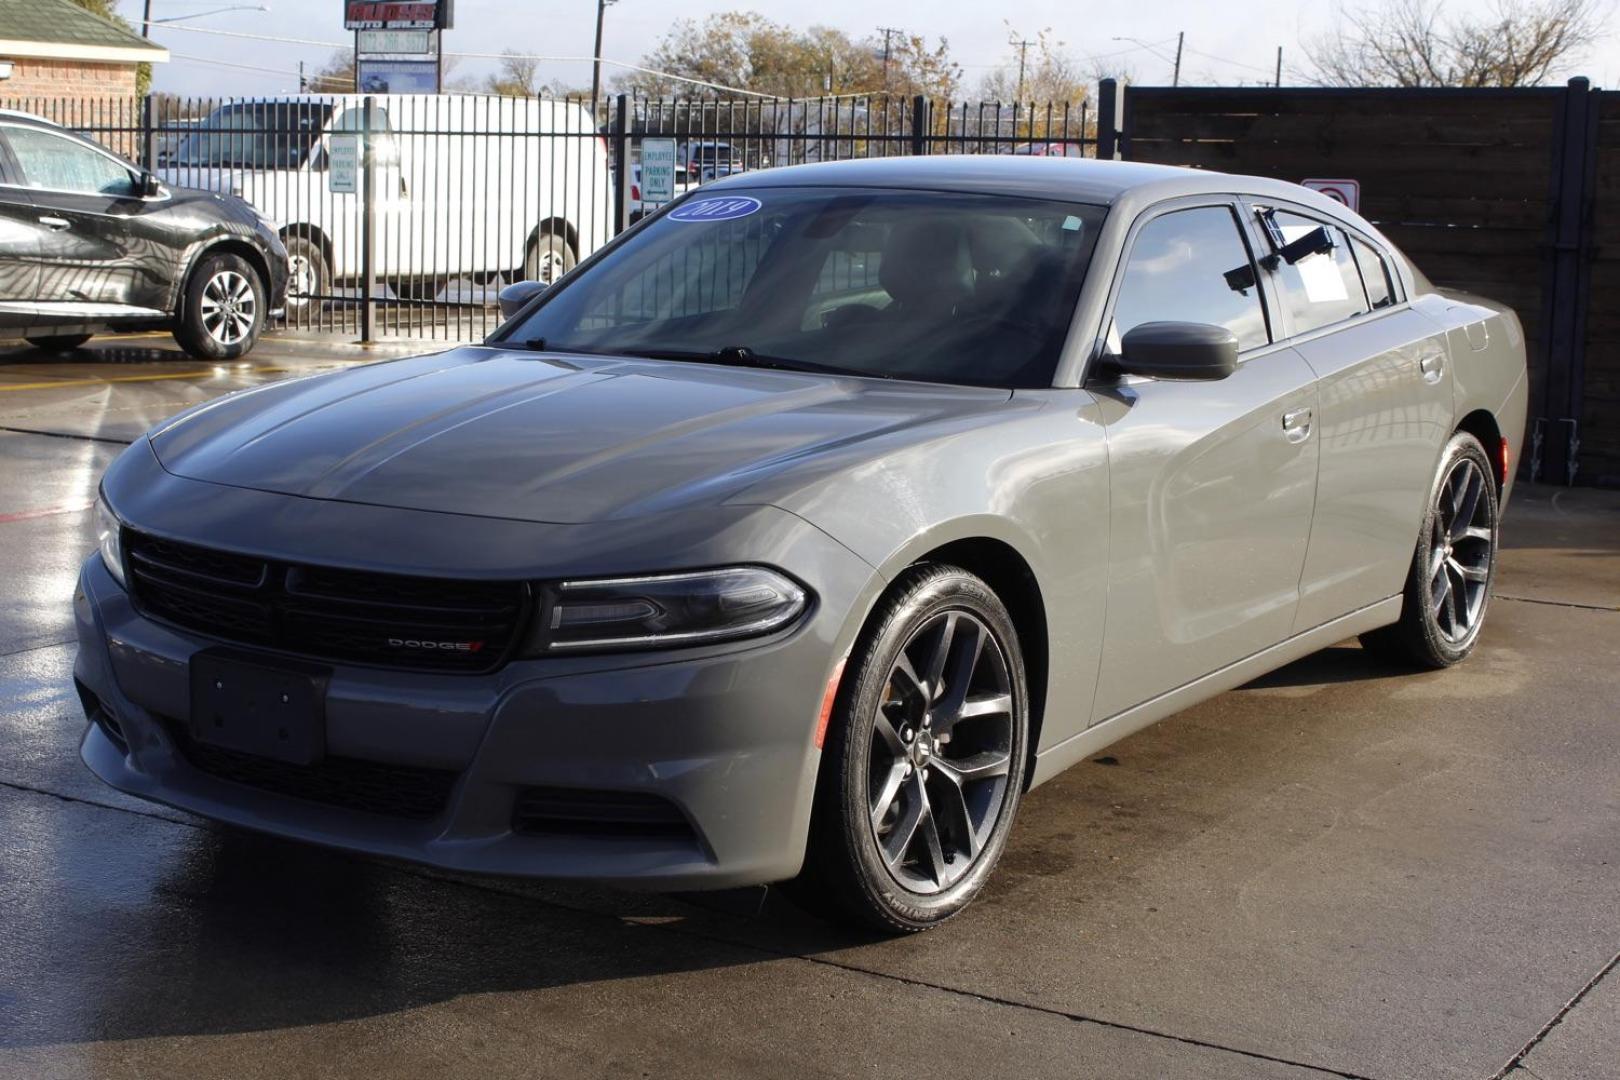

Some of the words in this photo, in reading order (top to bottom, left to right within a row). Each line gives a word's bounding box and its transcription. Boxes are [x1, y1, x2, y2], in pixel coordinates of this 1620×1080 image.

[345, 21, 382, 29] AUTO
[386, 21, 434, 29] SALES
[645, 152, 673, 161] EMPLOYEE
[646, 167, 672, 177] PARKING
[649, 177, 665, 188] ONLY
[676, 201, 752, 216] 2019
[389, 638, 472, 650] DODGE
